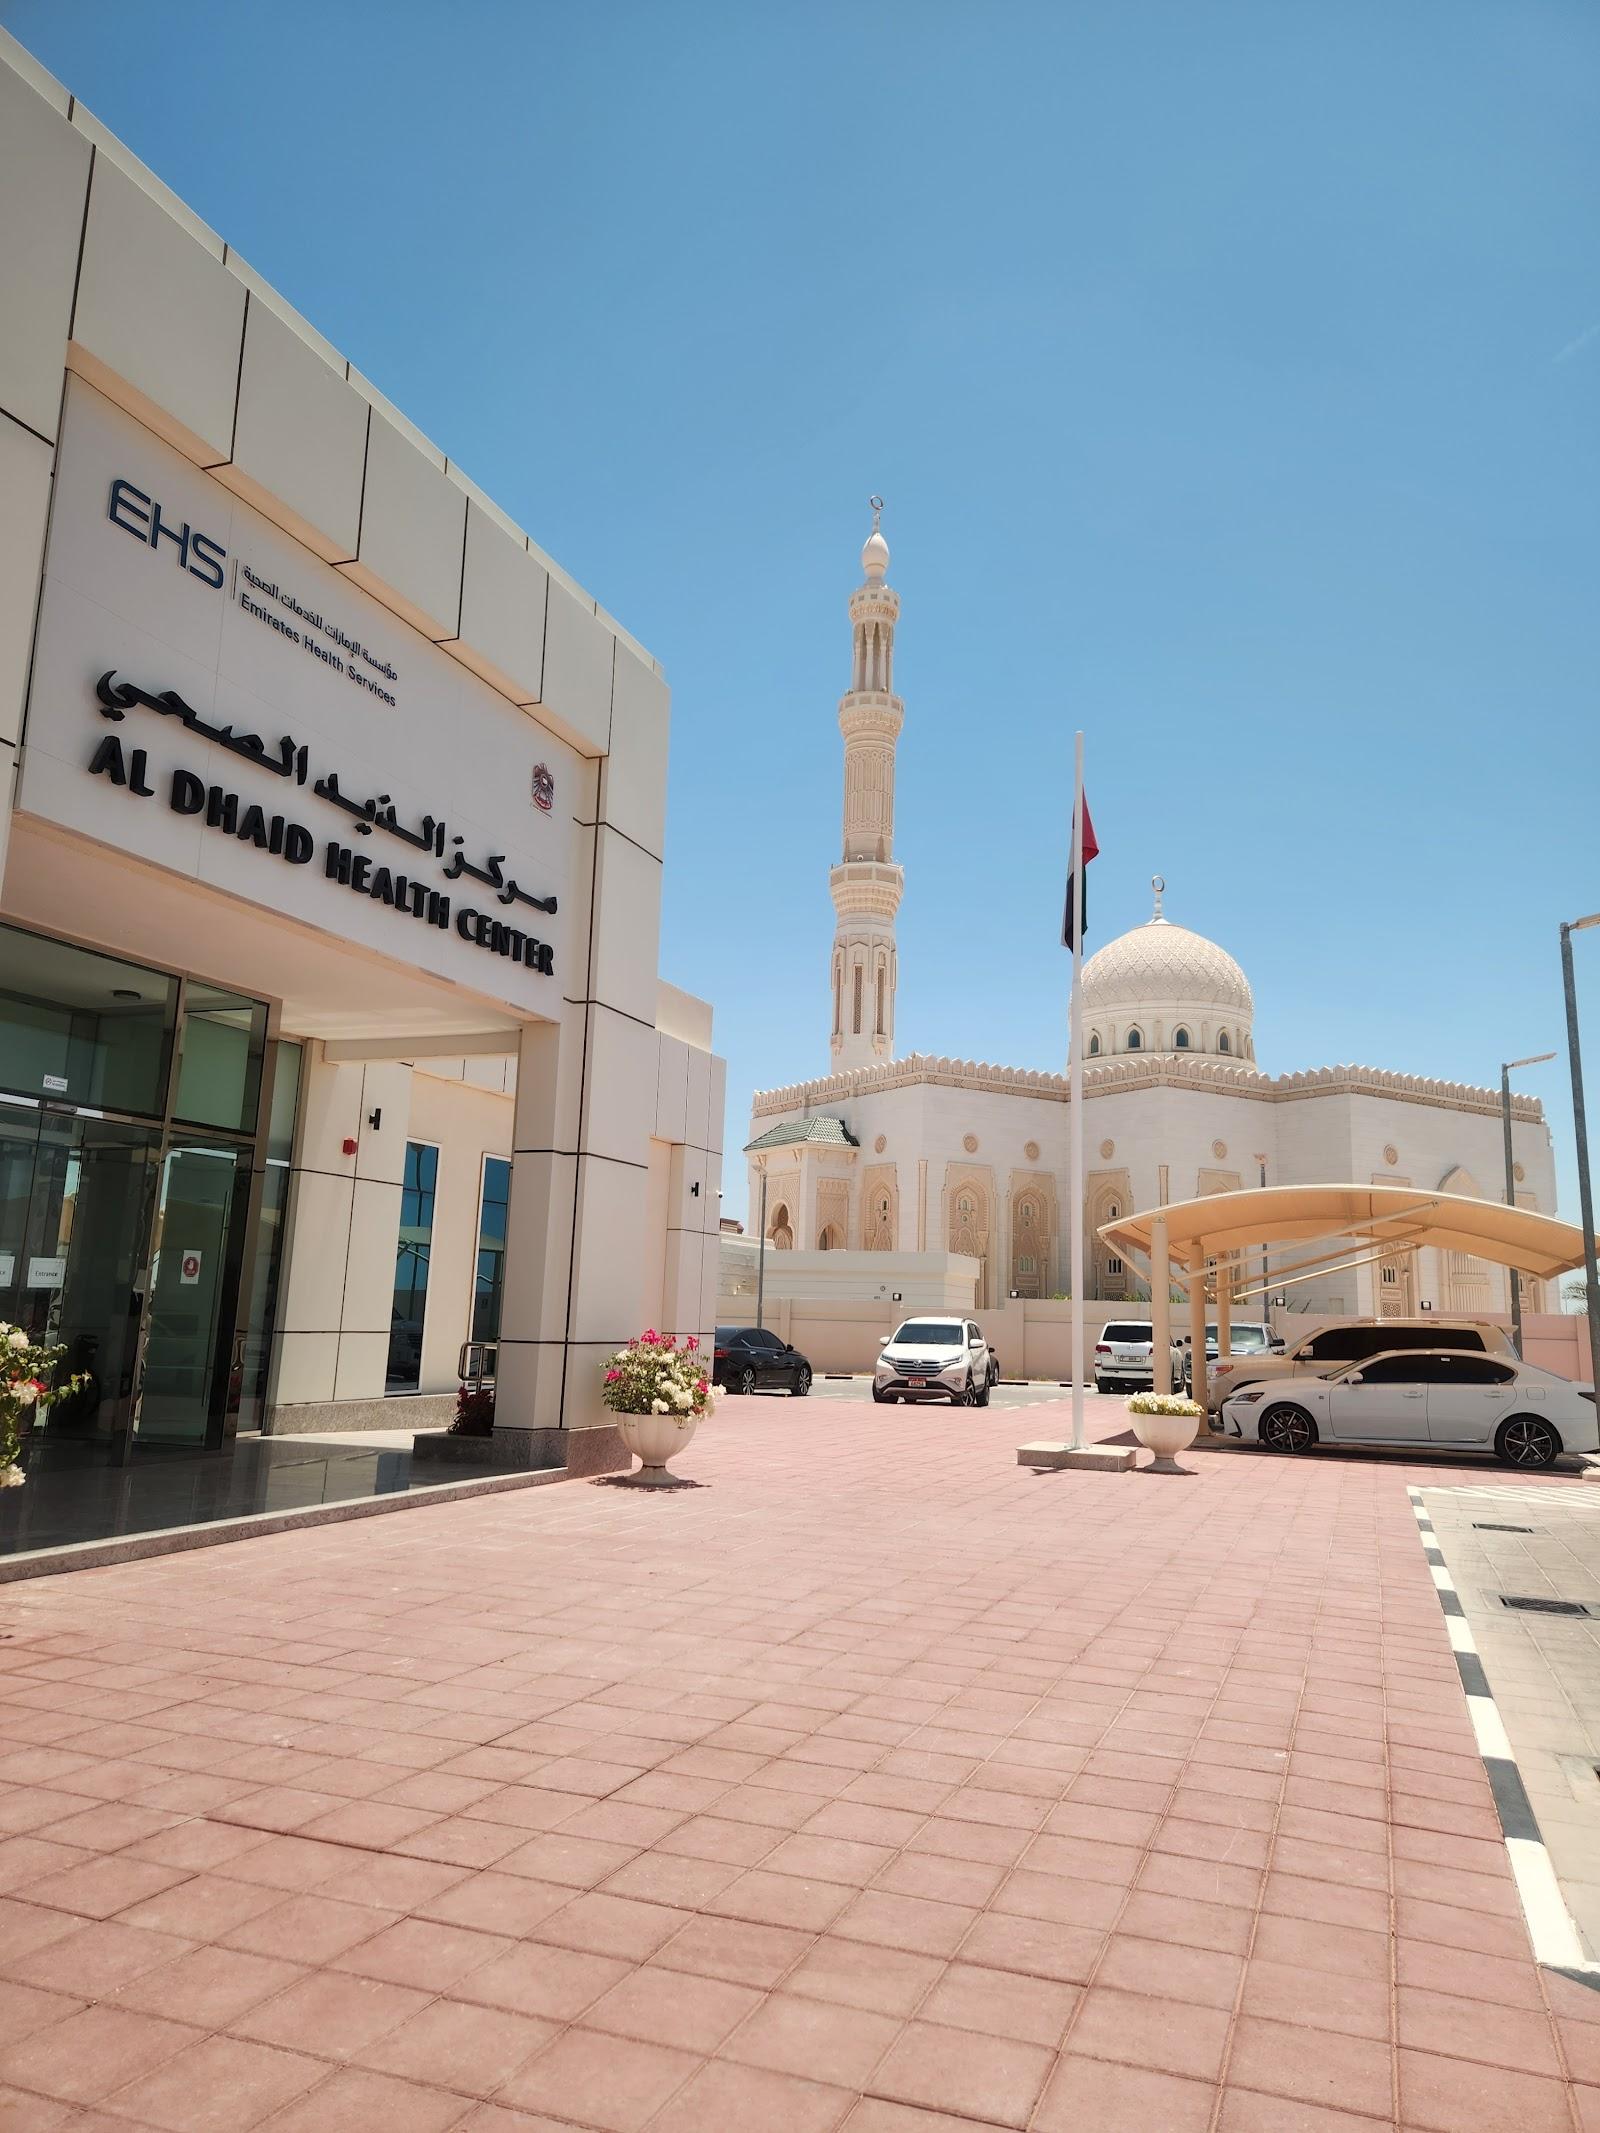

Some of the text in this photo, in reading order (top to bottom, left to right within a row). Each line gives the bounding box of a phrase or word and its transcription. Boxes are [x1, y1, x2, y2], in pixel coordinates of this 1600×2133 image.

[109, 480, 226, 589] EHS
[243, 566, 279, 600] الصحية
[241, 592, 396, 706] Emirates Health Services
[281, 594, 323, 629] للخدمات
[362, 649, 398, 681] مؤسسة
[96, 670, 558, 914] مركز الذيد الصحي
[88, 735, 554, 976] AL DHAID HEALTH CENTER
